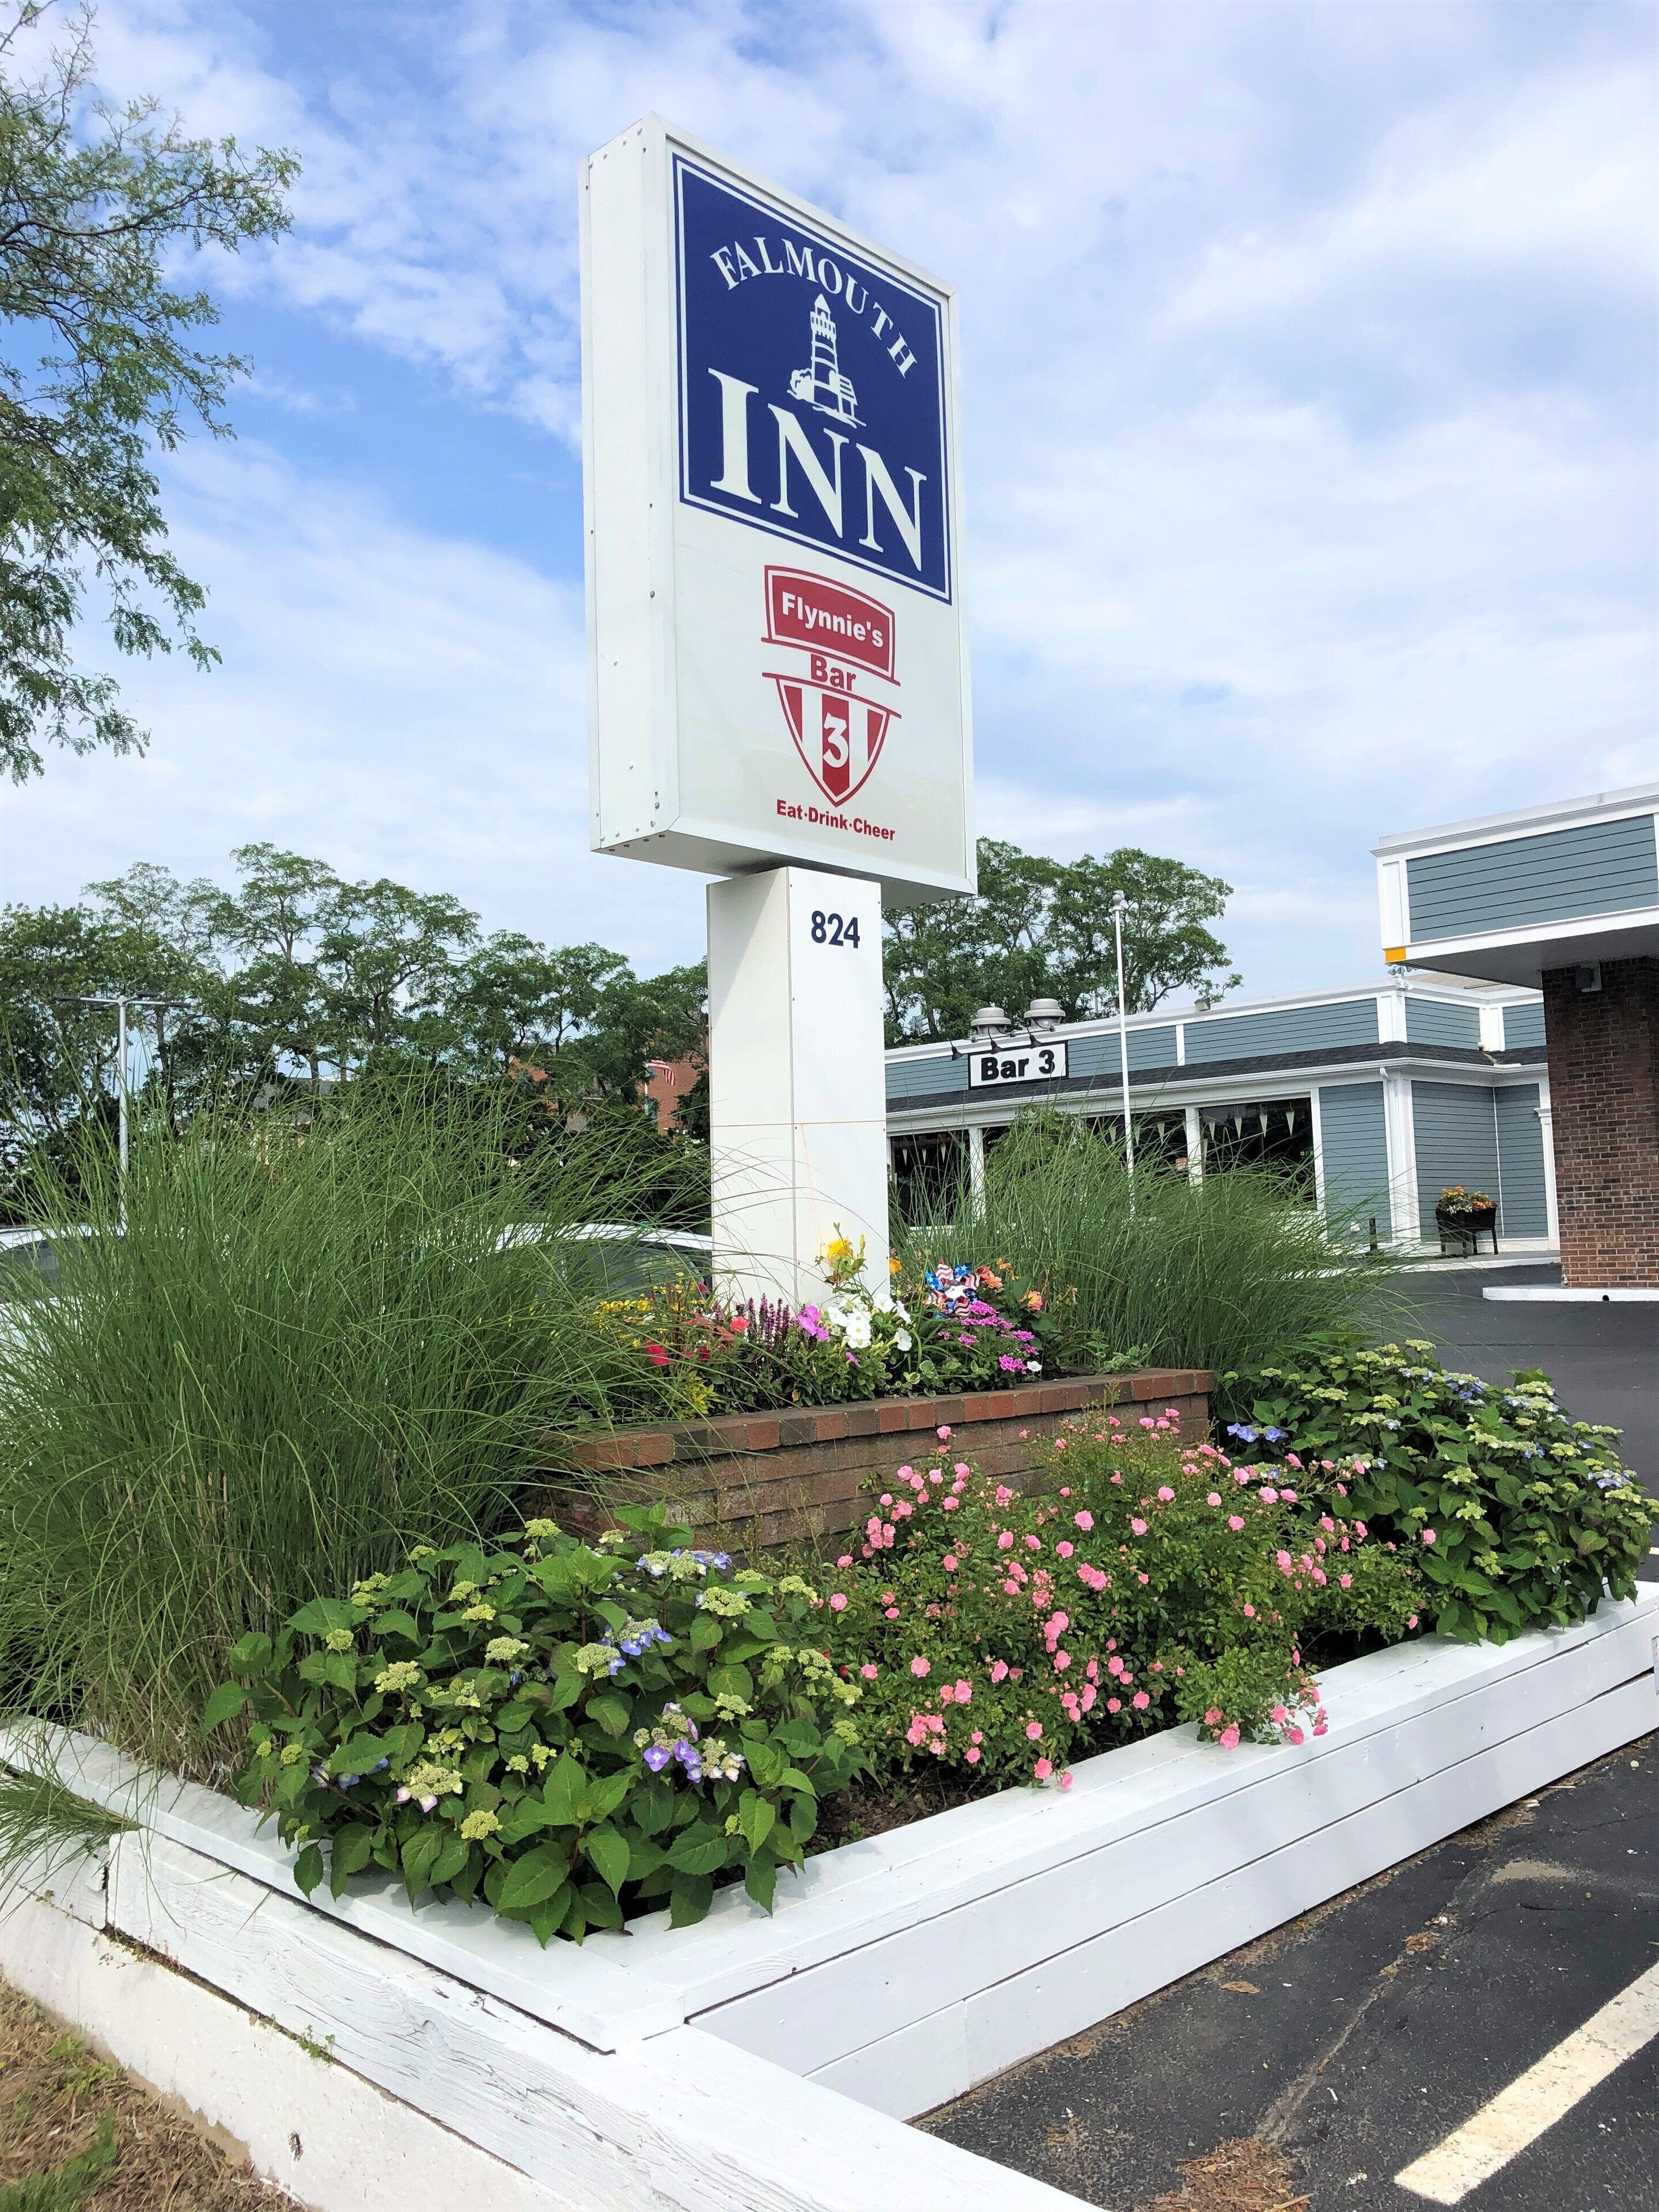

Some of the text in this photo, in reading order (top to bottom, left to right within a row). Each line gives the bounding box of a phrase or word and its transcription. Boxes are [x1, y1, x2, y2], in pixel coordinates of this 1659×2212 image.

[710, 237, 918, 378] FALMOUTH
[707, 367, 927, 571] INN
[781, 591, 884, 648] Flynnie's
[810, 653, 857, 691] Bar
[823, 712, 850, 768] 3
[810, 910, 861, 949] 824
[980, 1049, 1055, 1081] Bar 3
